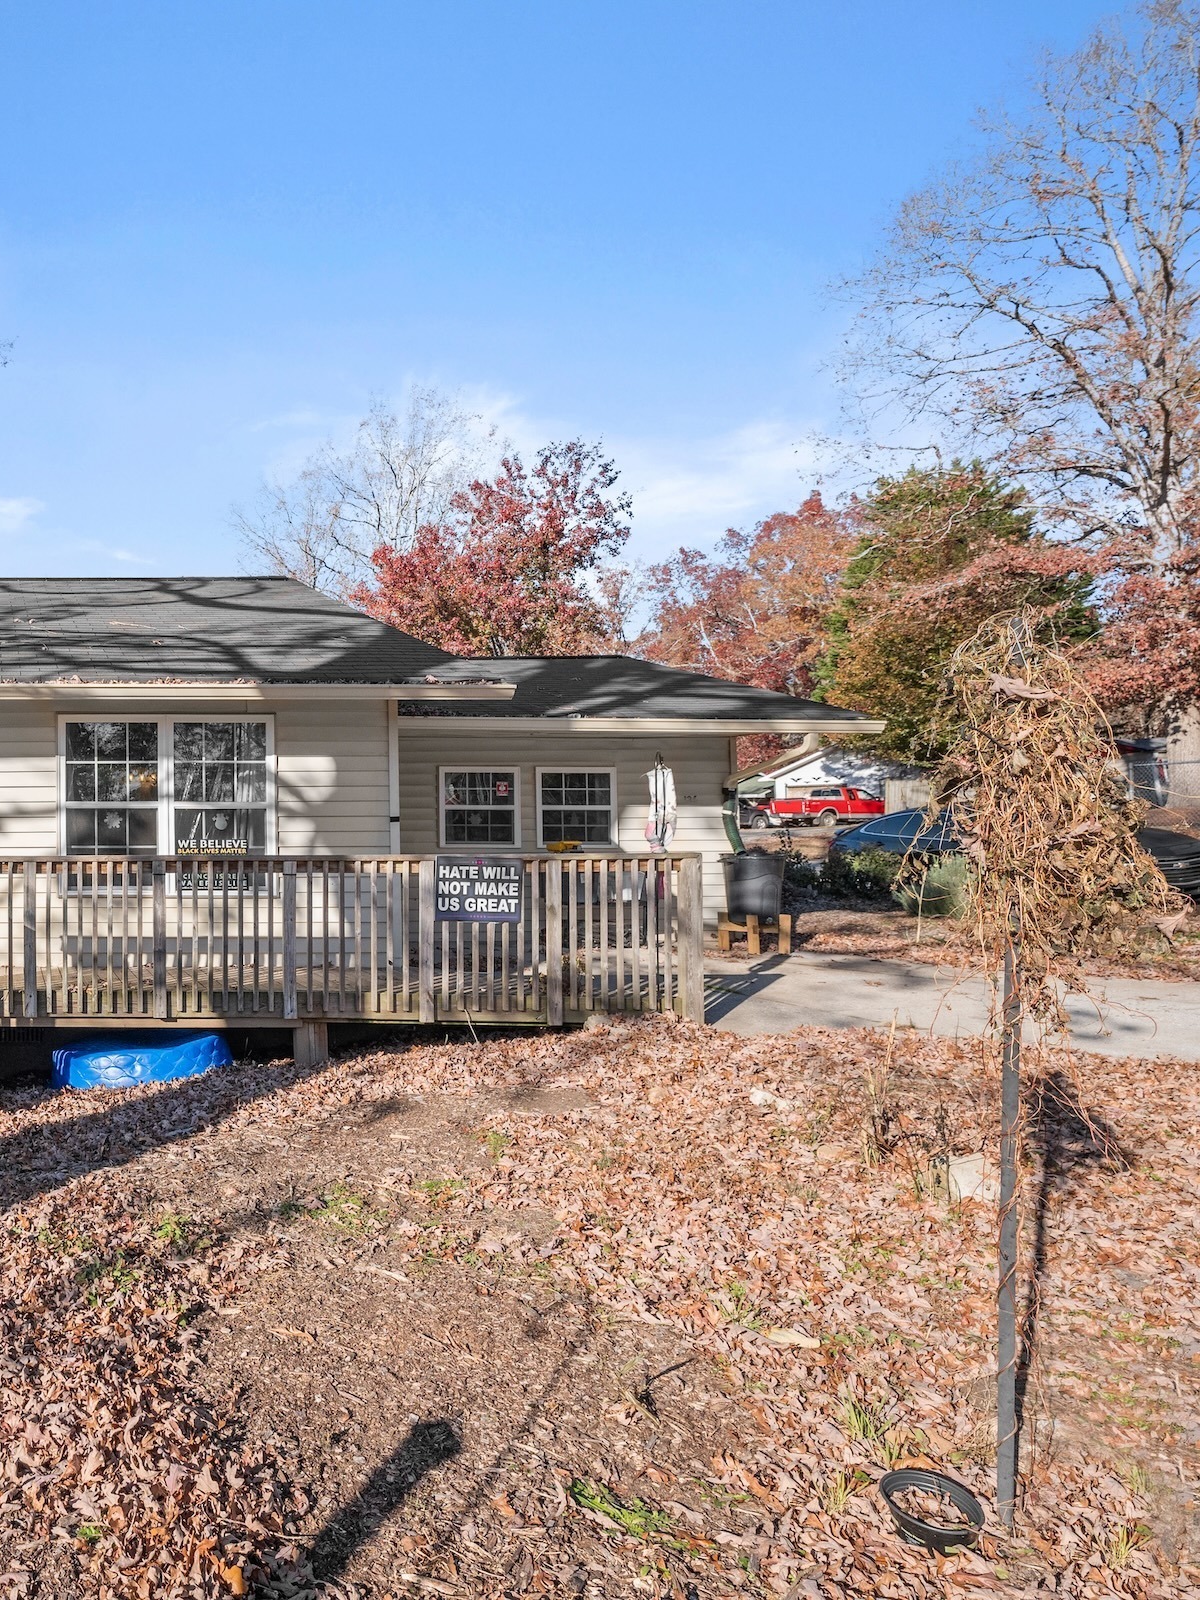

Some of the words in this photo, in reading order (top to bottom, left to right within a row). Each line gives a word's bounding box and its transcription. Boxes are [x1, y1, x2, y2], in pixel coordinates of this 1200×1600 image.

[178, 840, 197, 848] WE
[200, 840, 247, 848] BELIEVE
[439, 866, 478, 879] HATE
[482, 866, 519, 880] WILL
[438, 881, 471, 895] NOT
[474, 882, 519, 896] MAKE
[437, 897, 460, 912] US
[464, 897, 519, 913] GREAT
